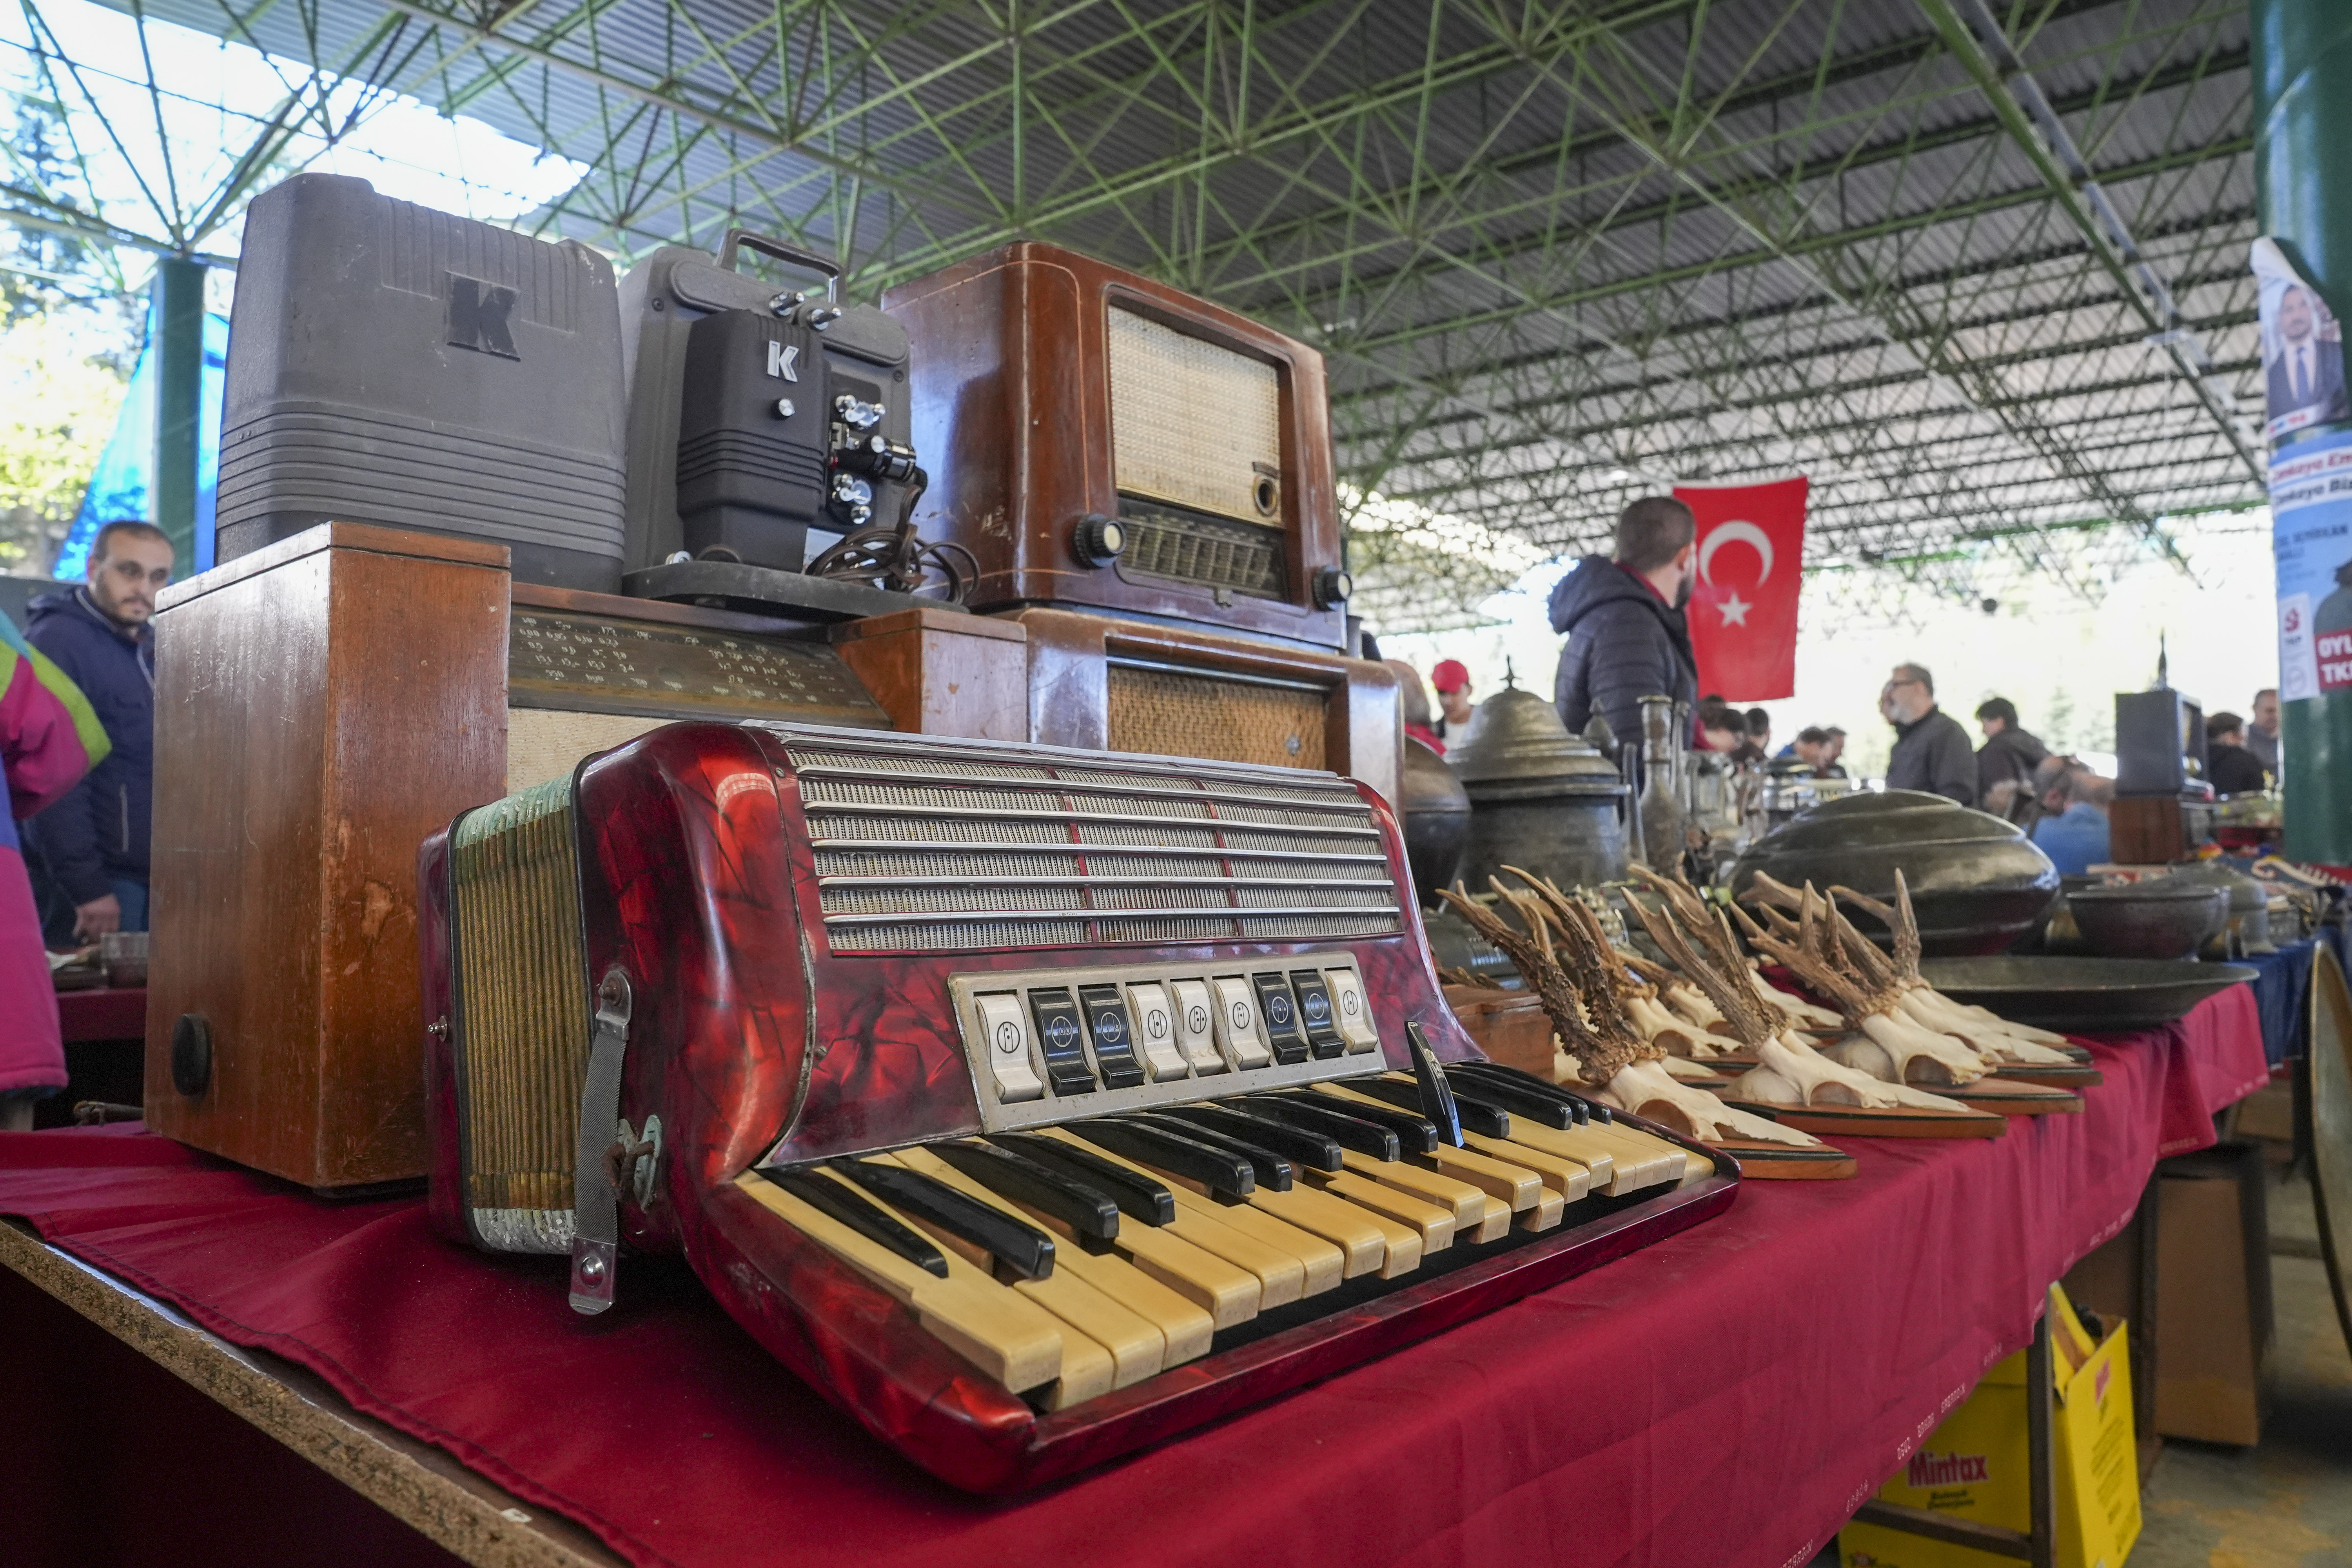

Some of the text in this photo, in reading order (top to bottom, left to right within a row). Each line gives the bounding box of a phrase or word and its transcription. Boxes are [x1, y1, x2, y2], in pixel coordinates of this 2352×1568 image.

[446, 271, 521, 361] K
[767, 340, 799, 382] K
[1909, 1451, 1988, 1487] Mintax
